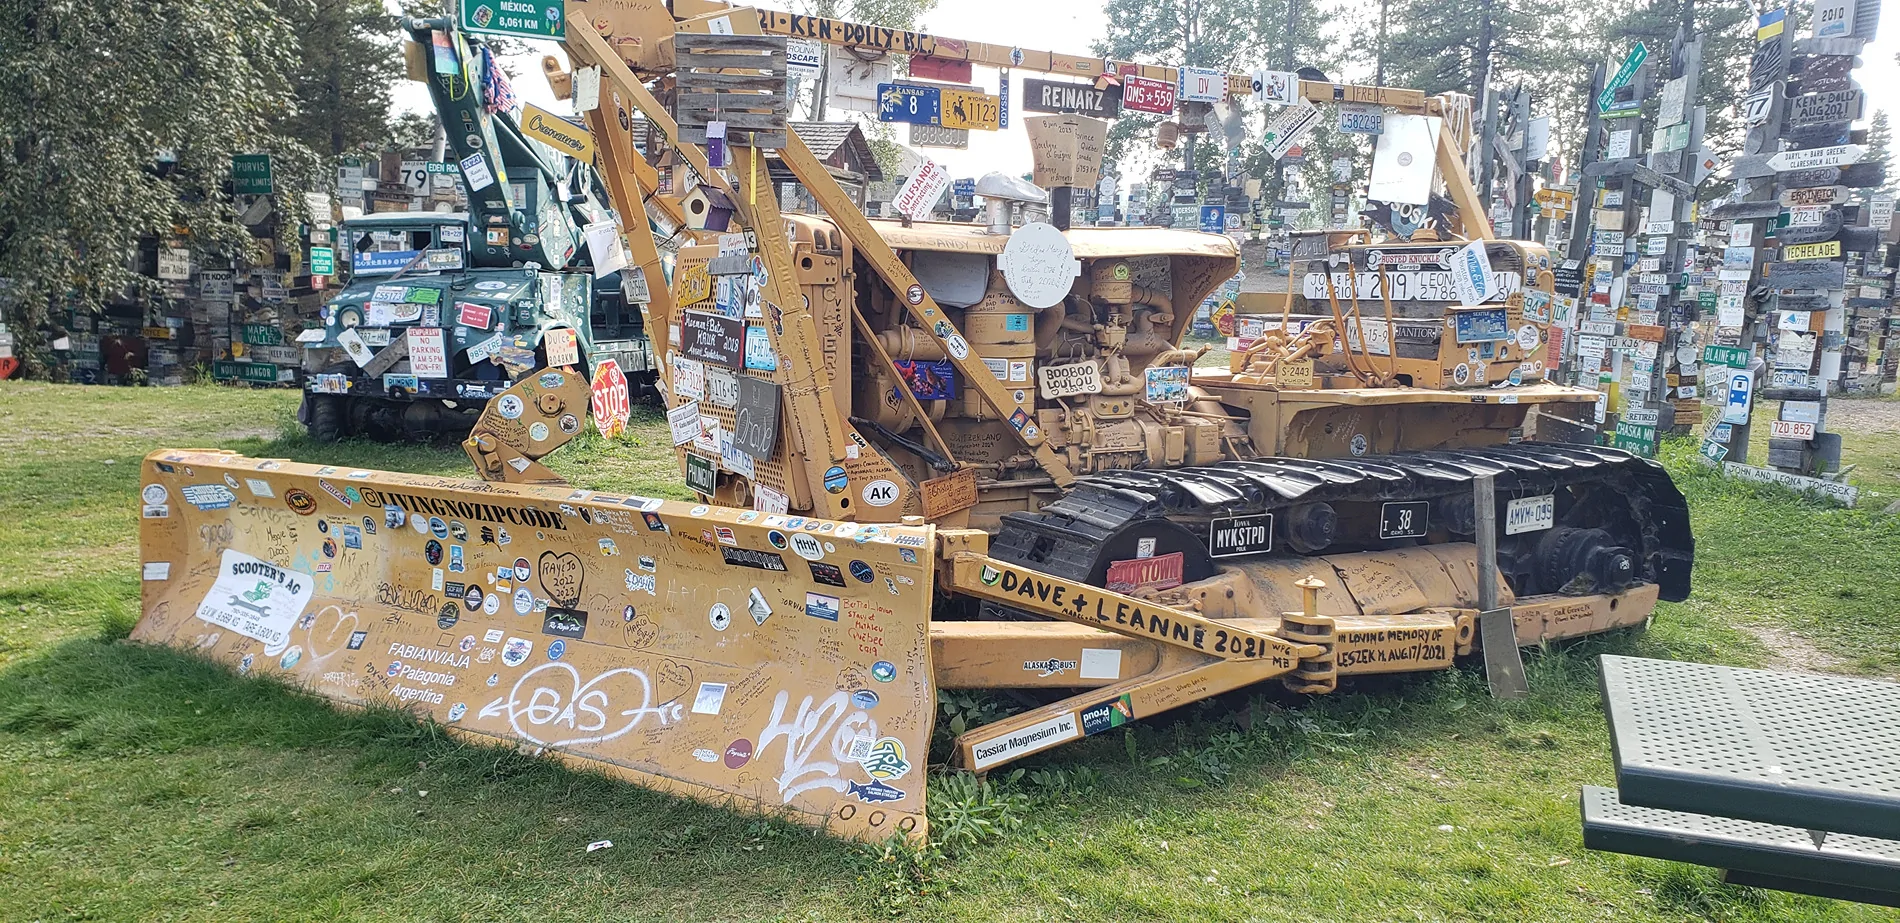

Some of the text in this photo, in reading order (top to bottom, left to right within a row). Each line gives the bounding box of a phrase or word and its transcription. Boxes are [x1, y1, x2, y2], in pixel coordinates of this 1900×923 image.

[1821, 7, 1845, 22] 2010
[499, 17, 538, 29] 8,061 KM
[791, 14, 831, 40] KEN
[1189, 67, 1219, 76] FLORIDA
[895, 86, 925, 97] KANSAS
[1138, 79, 1163, 89] OKLAHOMA
[1198, 77, 1210, 93] DV
[1042, 85, 1104, 111] REINARZ
[1126, 85, 1173, 107] QMS 559
[1795, 90, 1857, 108] KEN DOLLY
[908, 96, 918, 115] 8
[1000, 82, 1008, 126] ODYSSEY
[1800, 102, 1849, 117] AUG 2021
[969, 103, 997, 122] 1123
[1279, 106, 1315, 139] LANDSCAPE
[1341, 113, 1382, 130] C58229P
[1785, 146, 1847, 161] DARYL BARB GREENE
[236, 161, 265, 172] PURVIS
[428, 163, 445, 173] EDEN
[463, 154, 482, 170] 2023
[1790, 159, 1823, 168] CLARESHOLM
[401, 169, 427, 188] 79
[898, 160, 936, 214] GULFSANDS
[1700, 219, 1716, 231] Route
[1381, 254, 1441, 264] BUSTED KNUCKLE
[201, 272, 231, 281] TE KOOP
[247, 325, 273, 335] MAPLE
[1397, 327, 1435, 338] JANITOR
[248, 334, 276, 345] VALLEY
[420, 337, 430, 345] NO
[547, 332, 570, 346] Dulce
[723, 335, 740, 353] 2018
[270, 350, 298, 359] KEEP RIGHT
[411, 346, 441, 354] PARKING
[469, 349, 484, 361] 985
[1705, 348, 1748, 366] BLAINE MN
[220, 365, 271, 378] NORTH BANGOR
[414, 363, 442, 371] MON-FRI
[1046, 365, 1094, 380] BOOBOO
[1047, 376, 1093, 390] LOULOU
[594, 383, 627, 419] STOP
[1628, 413, 1658, 421] RETIRED
[1616, 423, 1655, 441] CHASKA MN
[850, 432, 867, 449] KTM
[1625, 441, 1640, 454] 1996
[1728, 464, 1751, 476] JOHN
[1754, 470, 1771, 480] AND
[870, 486, 892, 500] AK
[377, 491, 568, 531] LIVINGNOZIPCODE
[1233, 519, 1251, 527] IOWA
[1399, 509, 1412, 530] 38
[1216, 526, 1265, 548] MYKSTPD
[232, 562, 302, 595] SCOOTER'S AG
[553, 577, 575, 587] 2022
[1001, 570, 1067, 607] DAVE
[1097, 598, 1207, 651] LEANNE
[1215, 631, 1265, 659] 2021
[1348, 631, 1385, 645] LOVING
[1388, 629, 1430, 642] MEMORY
[1432, 629, 1444, 643] OF
[387, 642, 471, 669] FABIANVIAJA
[1336, 650, 1377, 667] LESZEK
[1024, 660, 1077, 670] ALASKA BUST
[398, 664, 456, 686] Patagonia
[389, 682, 444, 705] Argentina
[527, 685, 608, 731] GAS
[1083, 706, 1110, 723] Proud
[1084, 714, 1110, 729] Air North
[976, 722, 1074, 760] Cassiar Magnesium Inc.
